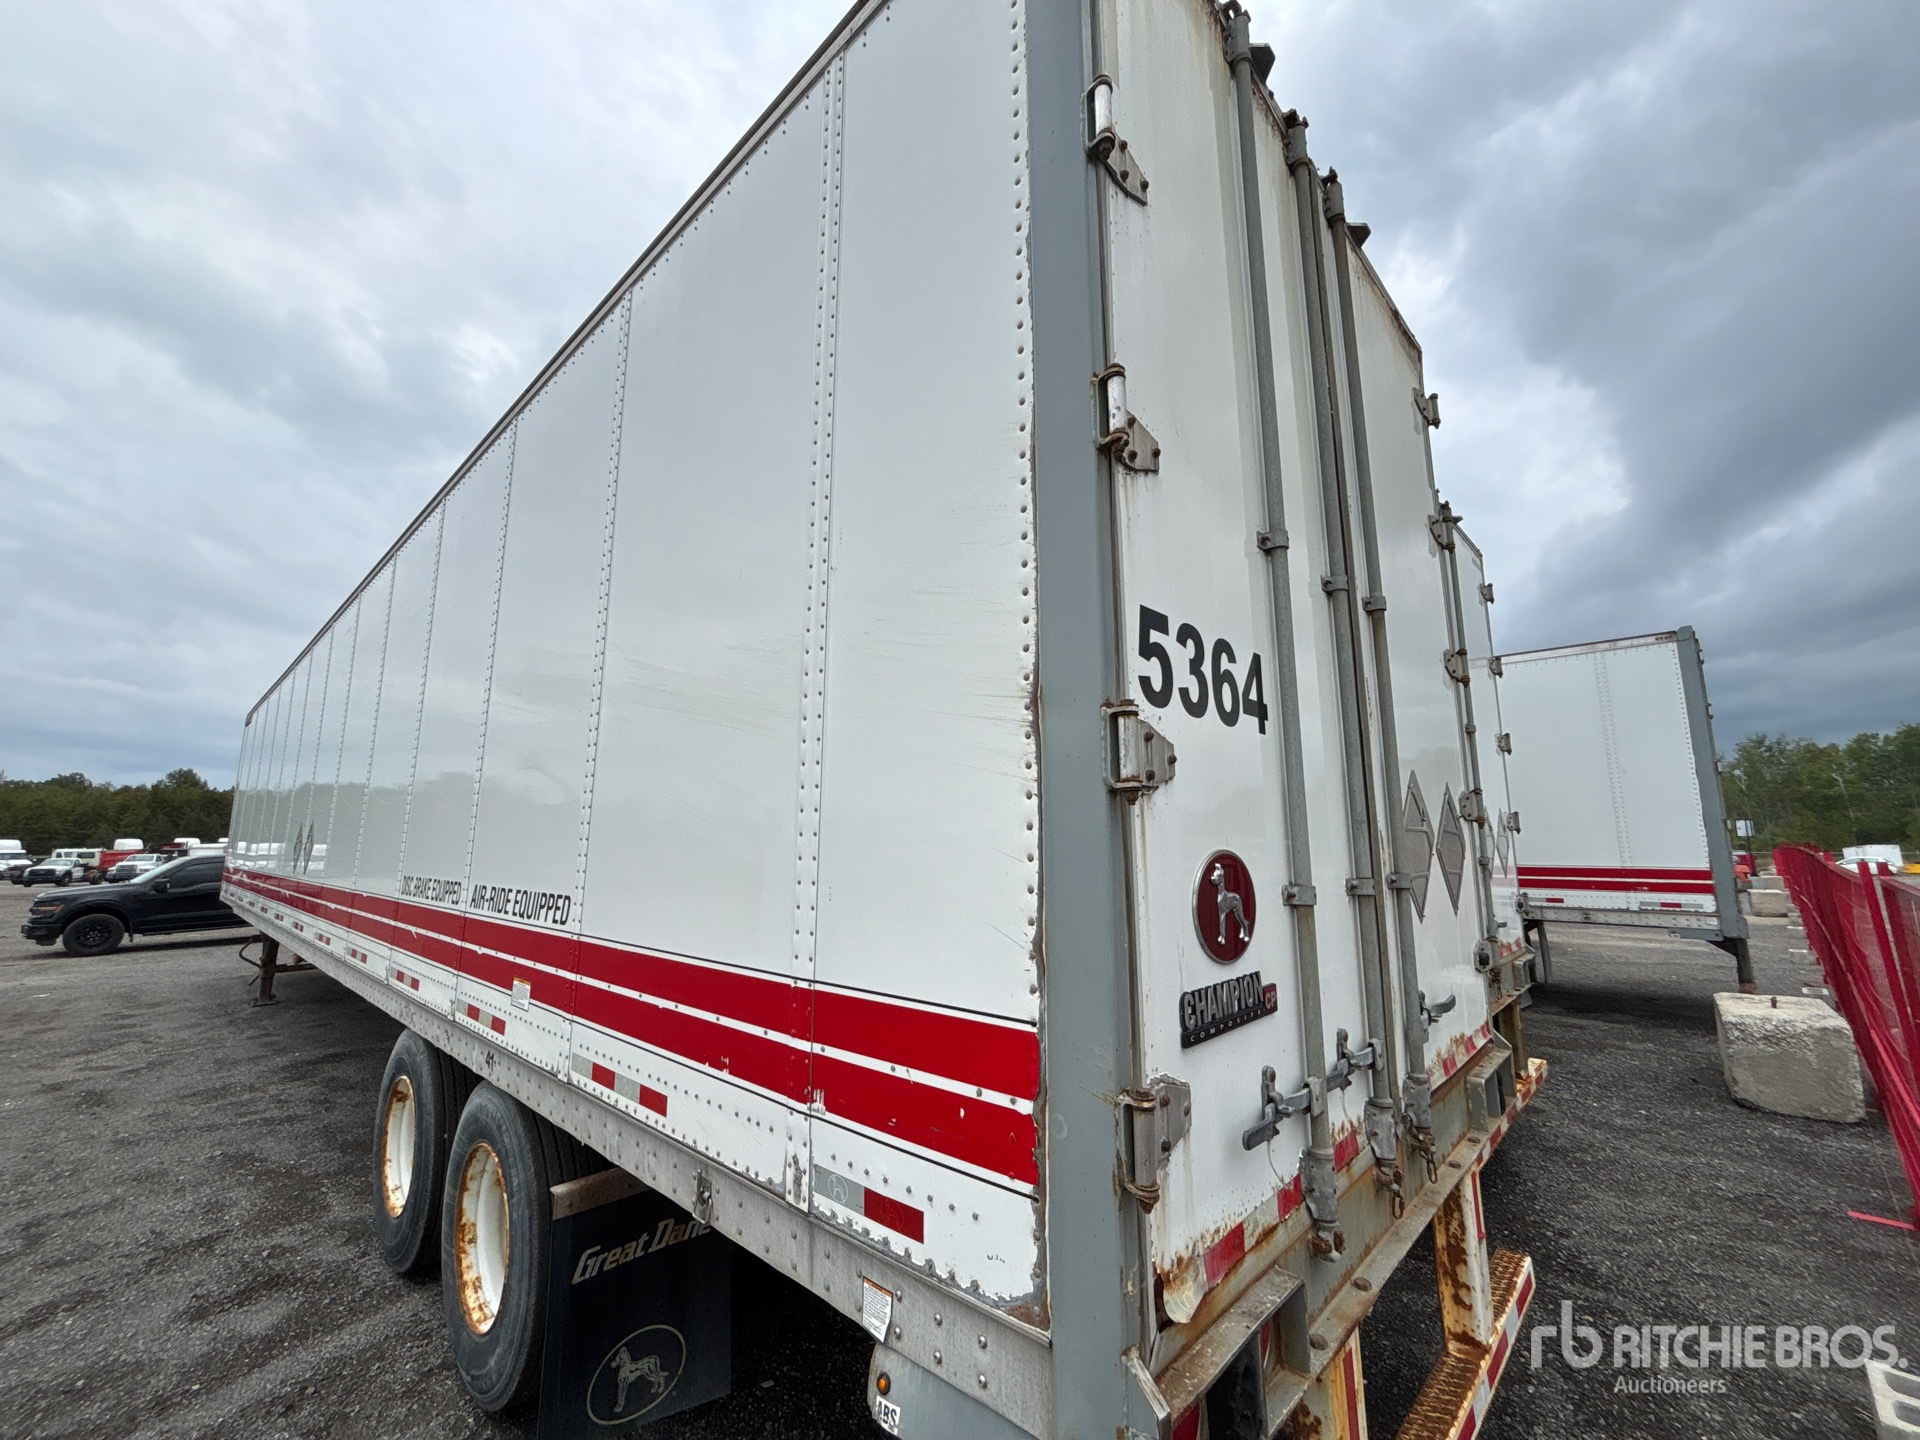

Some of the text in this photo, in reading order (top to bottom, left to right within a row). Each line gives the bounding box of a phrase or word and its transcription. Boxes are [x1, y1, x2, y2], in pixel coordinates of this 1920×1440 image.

[1138, 604, 1268, 735] 5364
[413, 876, 432, 900] BRAKE
[431, 878, 462, 906] EQUIPPED
[470, 884, 572, 925] AIR-RIDE EQUIPPED
[1183, 972, 1263, 1031] CHAMPION
[1265, 990, 1276, 1010] CP
[1190, 1010, 1260, 1042] COMPOSITE
[571, 1231, 650, 1285] Great
